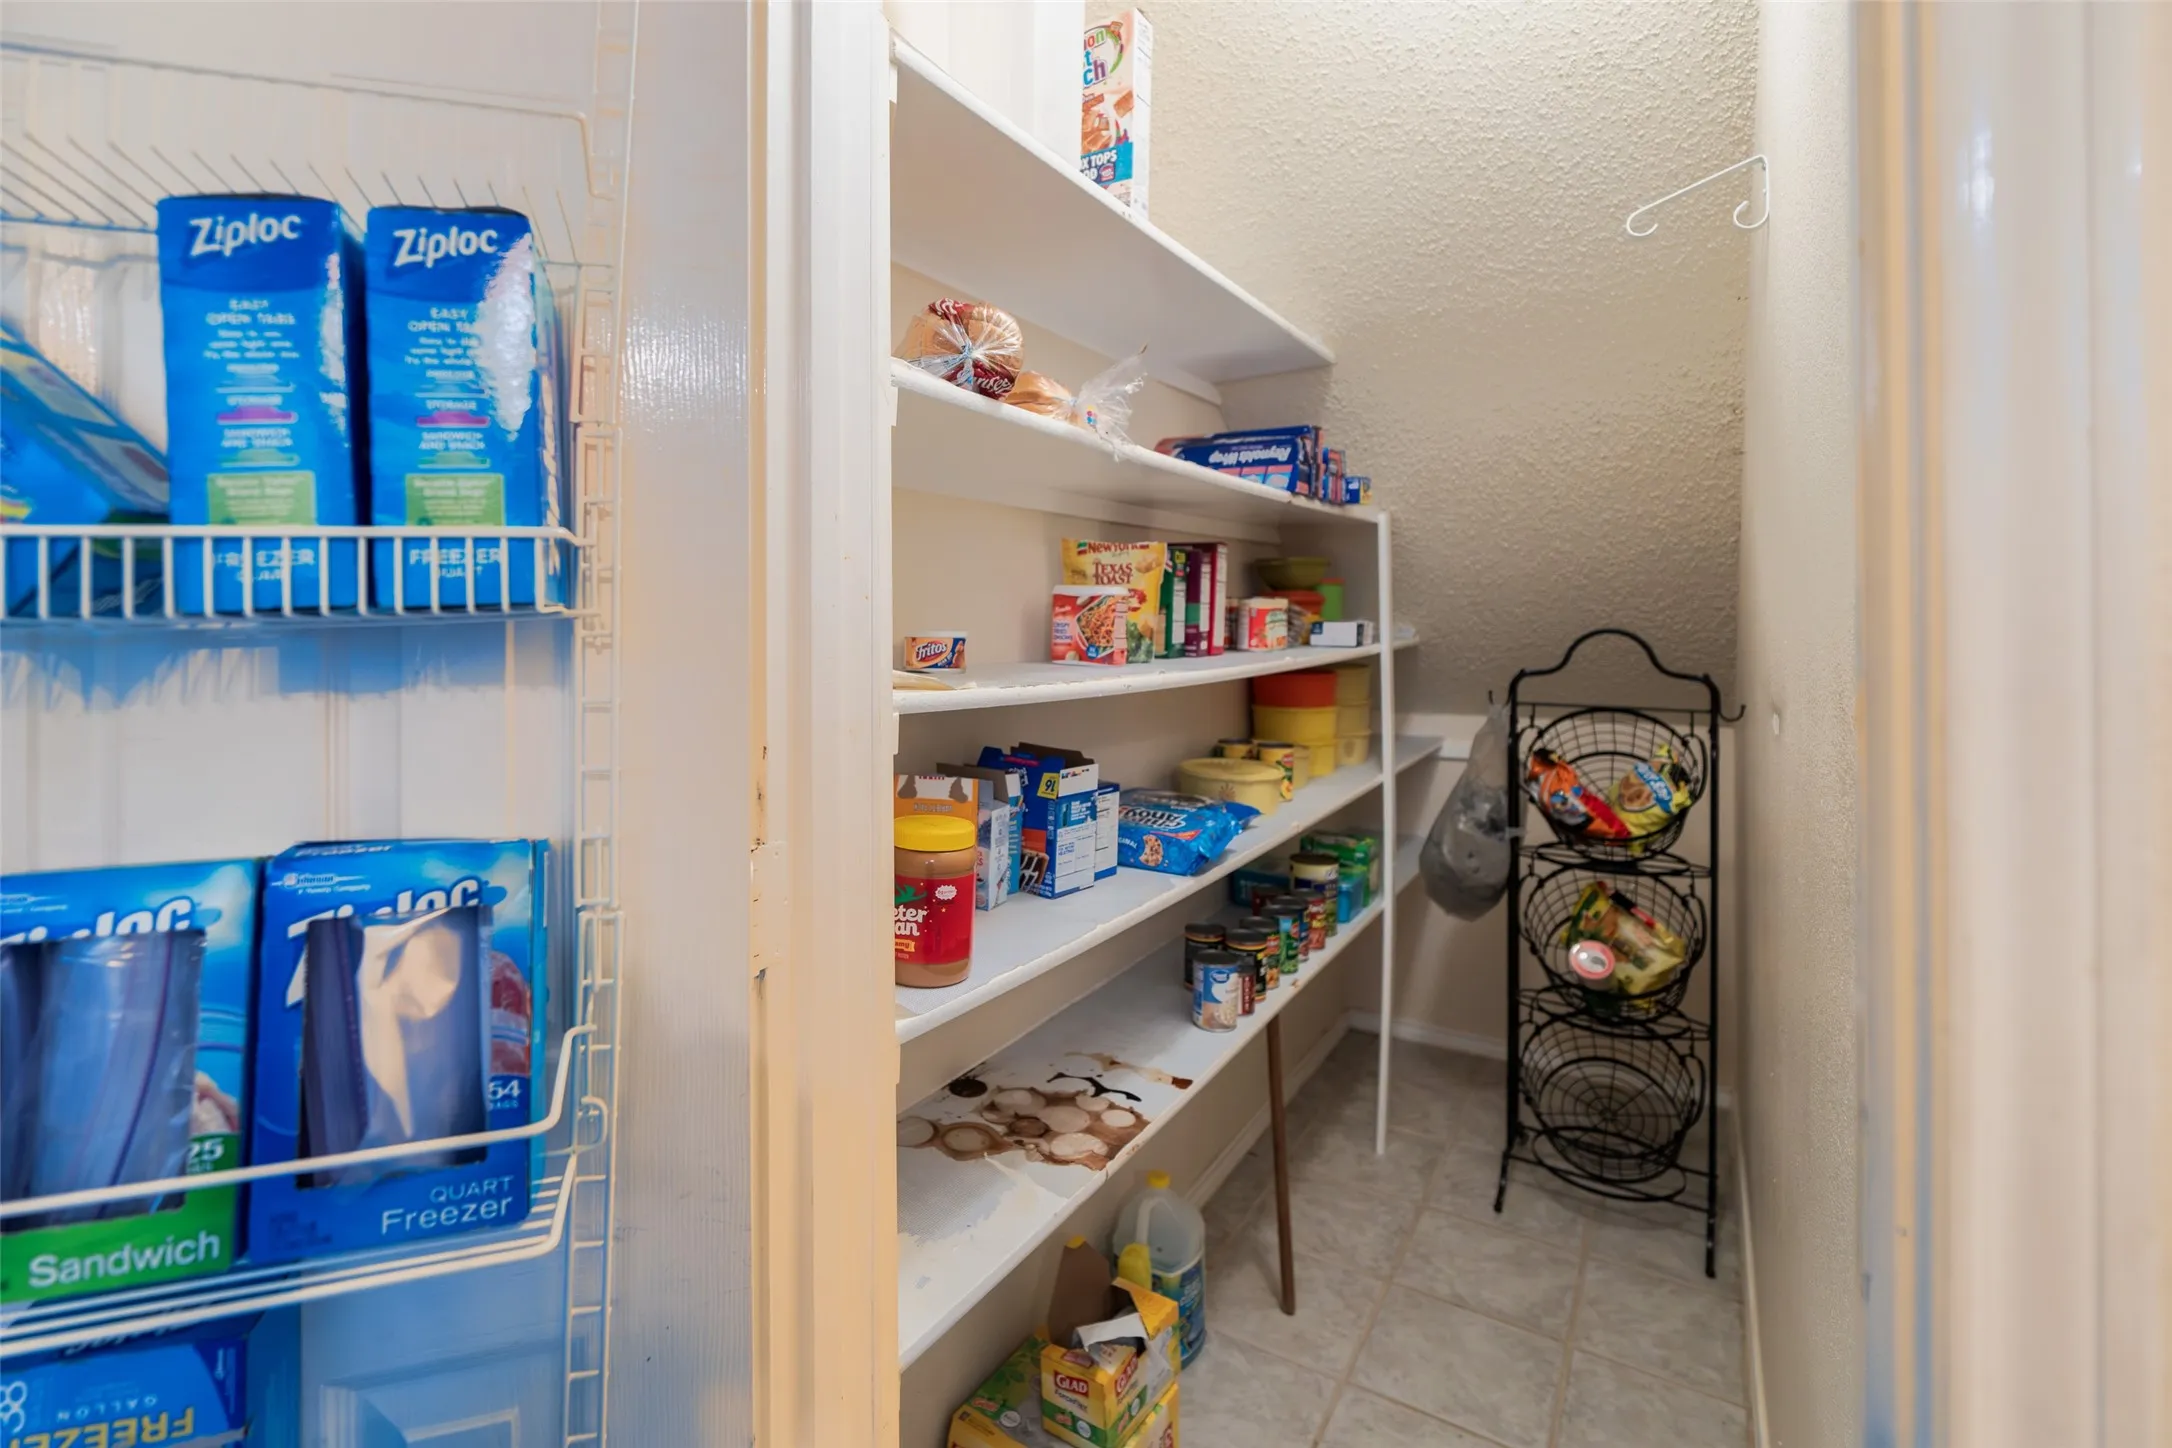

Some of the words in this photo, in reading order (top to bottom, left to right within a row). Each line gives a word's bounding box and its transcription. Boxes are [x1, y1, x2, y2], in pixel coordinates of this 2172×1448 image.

[189, 213, 302, 257] Ziploc
[394, 228, 498, 270] Ziploc
[1092, 558, 1133, 575] TEXAS
[916, 642, 948, 661] Fritos
[488, 1080, 521, 1100] 54
[430, 1175, 515, 1204] QUART
[381, 1192, 514, 1236] Freezer
[29, 1229, 221, 1287] Sandwich
[1056, 1374, 1088, 1394] GLAD
[56, 1393, 158, 1423] GALLON
[8, 1406, 194, 1448] FREEZE
